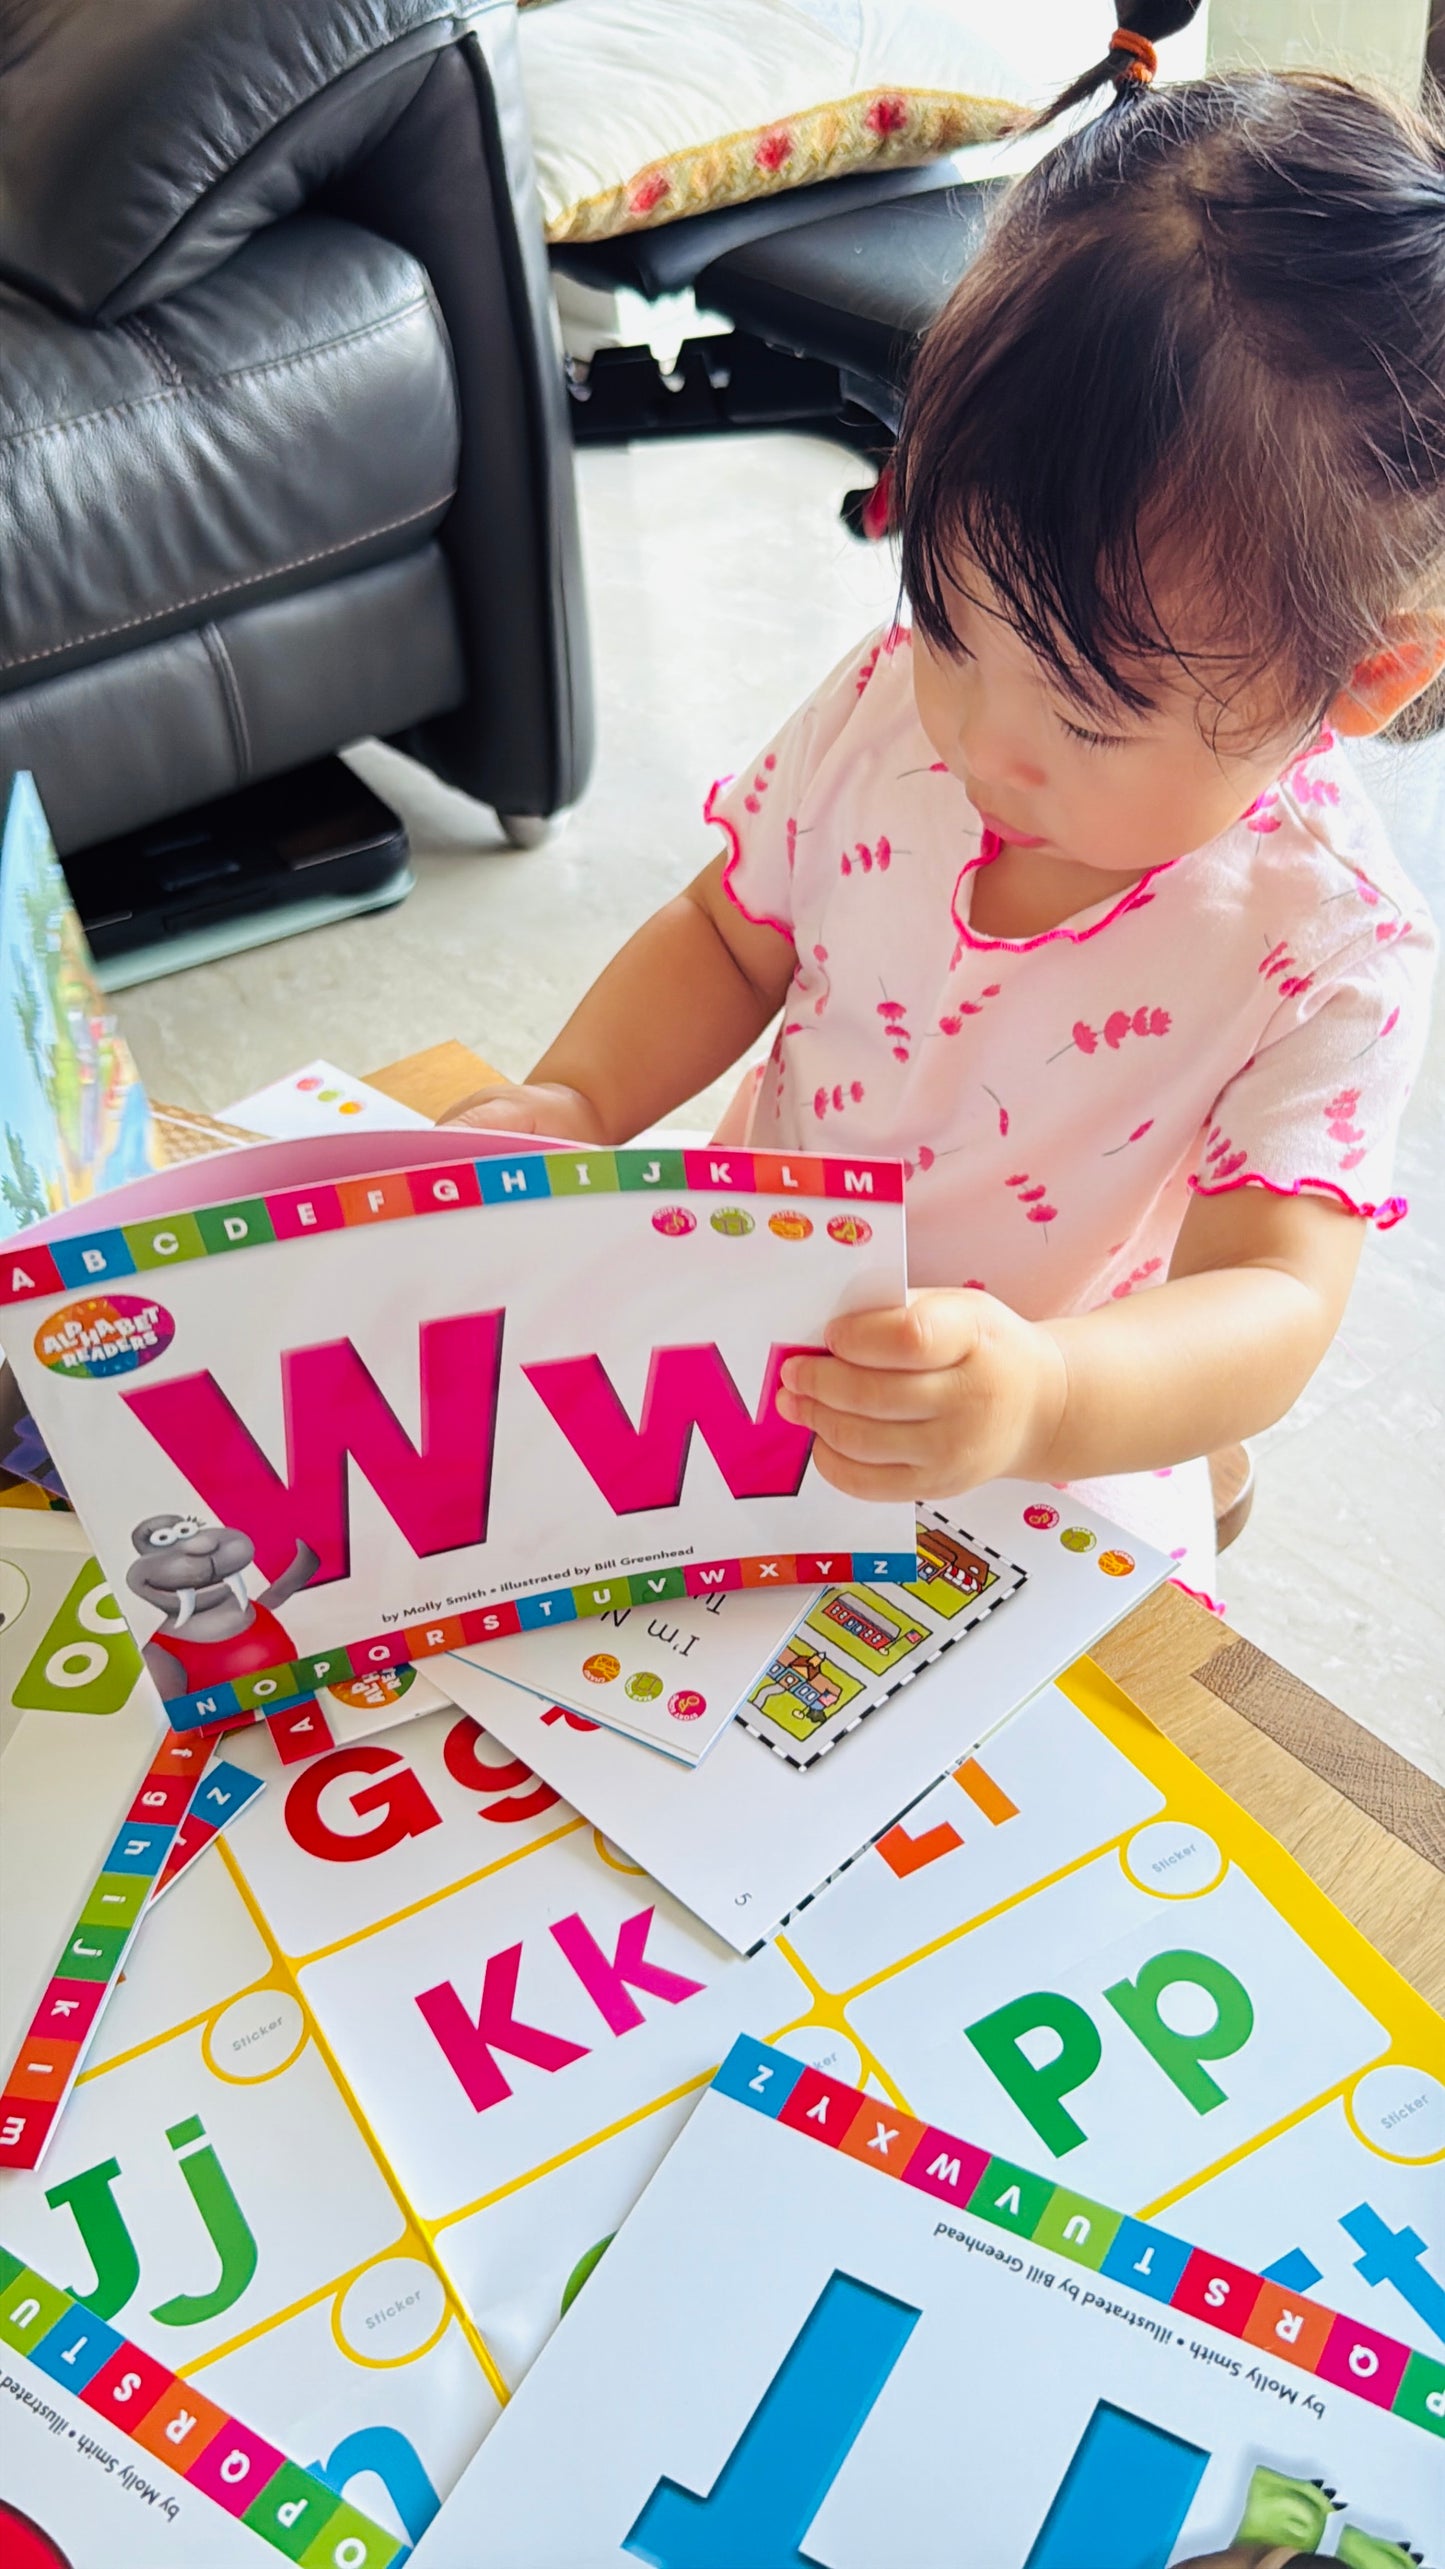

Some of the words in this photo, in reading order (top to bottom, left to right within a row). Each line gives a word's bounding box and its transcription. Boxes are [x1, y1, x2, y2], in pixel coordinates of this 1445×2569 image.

[12, 1267, 35, 1292] A
[81, 1249, 107, 1274] B
[152, 1232, 180, 1256] C
[223, 1217, 249, 1241] D
[296, 1202, 318, 1226] E
[367, 1190, 385, 1213] F
[432, 1180, 460, 1202] G
[501, 1170, 528, 1193] H
[575, 1163, 592, 1186] I
[641, 1161, 662, 1184] J
[709, 1163, 733, 1183] K
[781, 1167, 798, 1187] L
[843, 1170, 874, 1193] M
[42, 1306, 160, 1354] ALPHABET
[61, 1330, 159, 1368] READERS
[381, 1610, 399, 1624] by
[402, 1600, 443, 1619] Molly
[445, 1587, 487, 1606] Smith
[499, 1567, 571, 1593] illustrated
[574, 1564, 592, 1578] by
[594, 1558, 617, 1572] Bill
[619, 1546, 695, 1567] Greenhead
[195, 1697, 217, 1716] N
[252, 1679, 278, 1696] O
[313, 1661, 331, 1679] P
[367, 1645, 391, 1661] Q
[425, 1629, 444, 1646] R
[482, 1614, 500, 1631] S
[538, 1600, 553, 1617] T
[592, 1588, 612, 1605] U
[646, 1577, 667, 1594] V
[699, 1568, 726, 1585] W
[759, 1562, 780, 1578] X
[815, 1560, 833, 1575] Y
[873, 1560, 889, 1575] Z
[647, 1618, 700, 1657] I'm
[1151, 1843, 1198, 1874] Sticker
[414, 1904, 708, 2114] Kk
[232, 2015, 284, 2053] Sticker
[962, 1948, 1254, 2159] Pp
[748, 2064, 775, 2094] Z
[805, 2095, 831, 2125] Y
[1380, 2094, 1430, 2130] Sticker
[866, 2121, 900, 2156] X
[925, 2152, 962, 2187] W
[993, 2184, 1022, 2216] V
[44, 2113, 258, 2328] Jj
[1061, 2214, 1093, 2247] U
[932, 2221, 1024, 2273] Greenhead
[1132, 2247, 1156, 2275] T
[1025, 2264, 1056, 2288] Bill
[1057, 2277, 1080, 2302] by
[1203, 2277, 1231, 2308] S
[8, 2297, 42, 2330] U
[364, 2288, 423, 2331] Sticker
[1080, 2289, 1174, 2345] illustrated
[1274, 2308, 1305, 2345] R
[60, 2335, 89, 2366] T
[1188, 2338, 1244, 2378] Smith
[1348, 2343, 1380, 2378] Q
[112, 2371, 143, 2403] S
[1245, 2365, 1300, 2405] Molly
[0, 2374, 70, 2436] illustrated
[1302, 2389, 1327, 2420] by
[164, 2408, 198, 2446] R
[76, 2433, 120, 2474] Smith
[219, 2448, 252, 2484] Q
[117, 2464, 161, 2506] Molly
[160, 2495, 181, 2523] by
[276, 2497, 310, 2530] P
[332, 2536, 368, 2569] O
